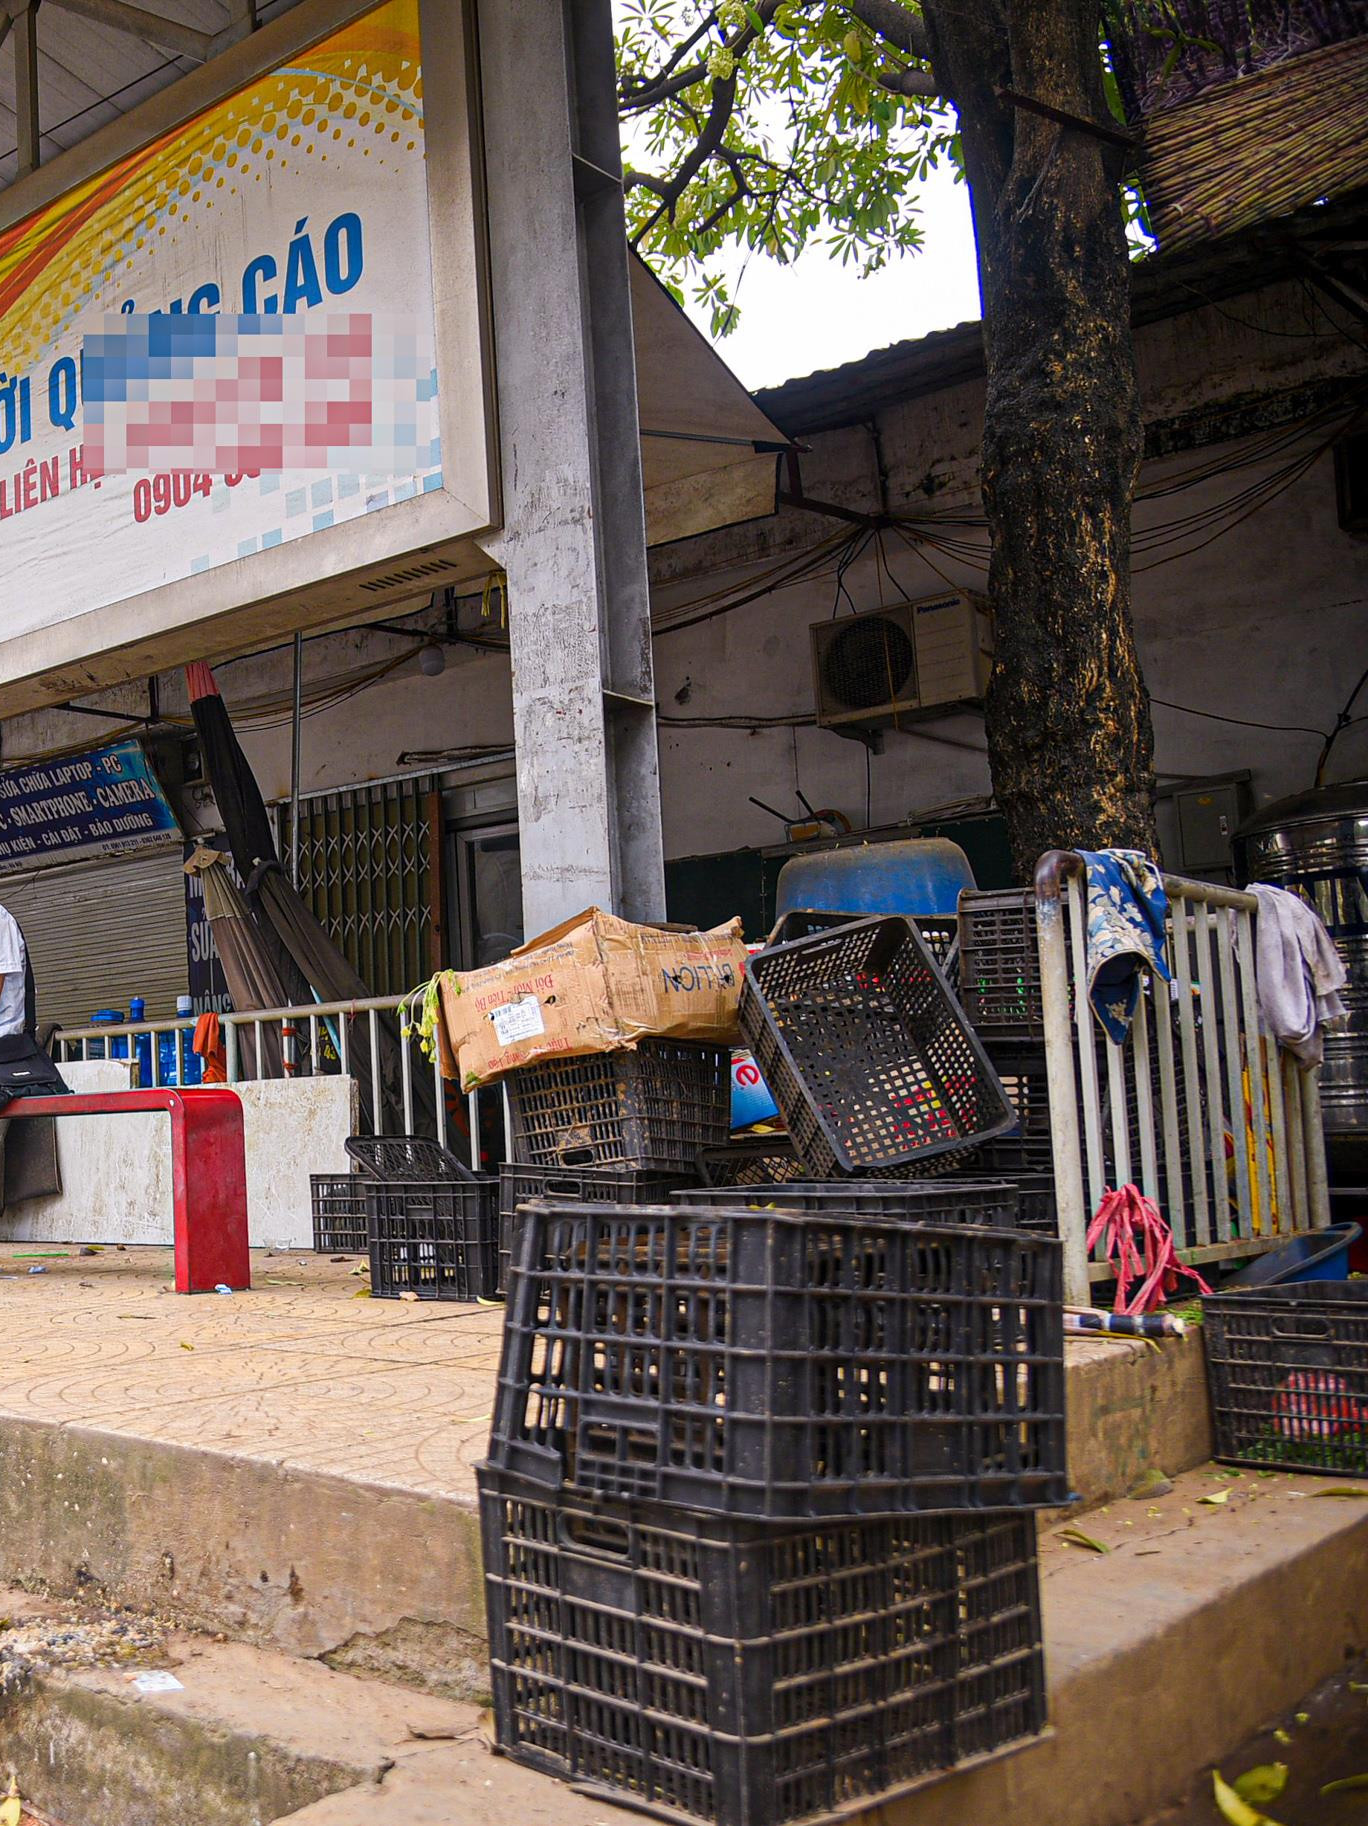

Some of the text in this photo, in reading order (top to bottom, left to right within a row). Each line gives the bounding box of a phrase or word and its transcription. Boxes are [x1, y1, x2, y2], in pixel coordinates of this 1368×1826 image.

[241, 212, 363, 315] CÁO
[50, 760, 92, 786] LAPTOP
[101, 754, 123, 774] PC
[9, 791, 93, 827] SMARTPHONE
[96, 778, 156, 808] CAMERA
[13, 835, 35, 854] KIỆN
[89, 818, 113, 837] BẢO
[114, 812, 153, 832] DƯỠNG
